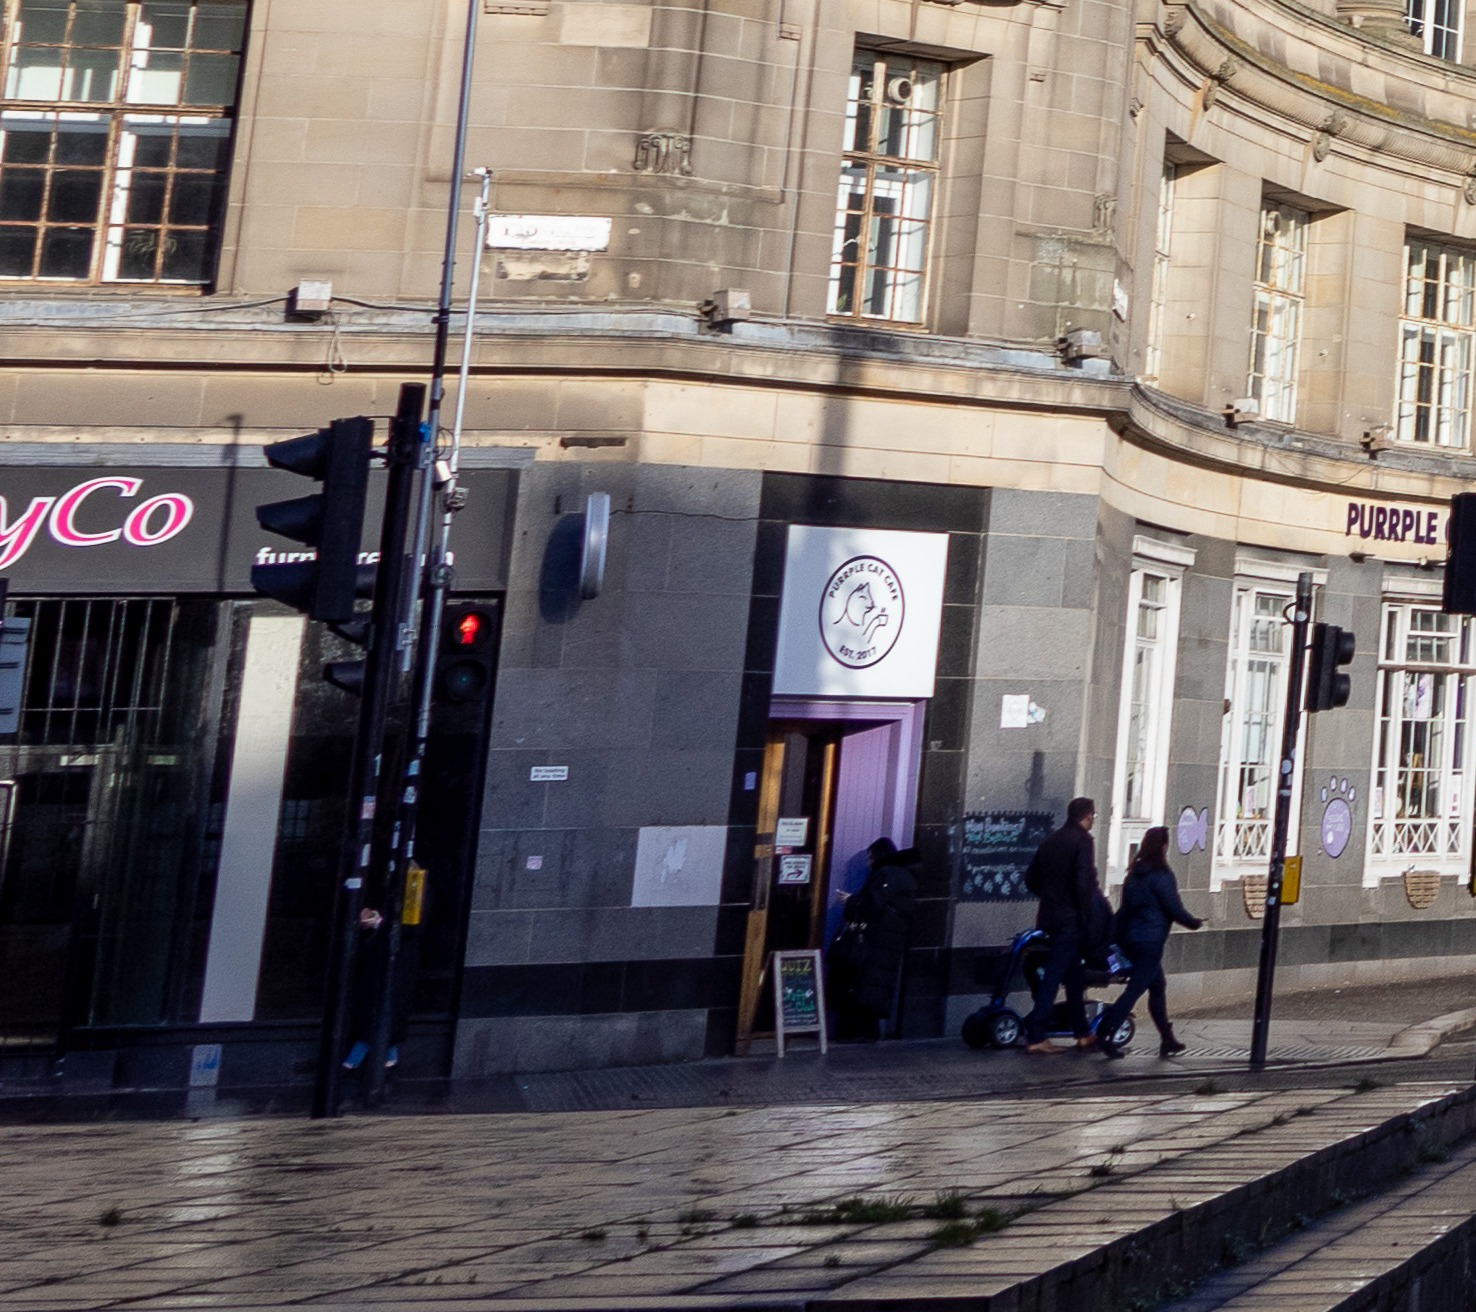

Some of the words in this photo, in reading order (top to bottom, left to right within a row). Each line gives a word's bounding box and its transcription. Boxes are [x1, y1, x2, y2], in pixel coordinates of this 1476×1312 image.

[1346, 502, 1438, 545] PURRPLE
[828, 563, 865, 599] PURRPLE
[867, 563, 885, 576] CAT
[856, 646, 876, 660] 2017
